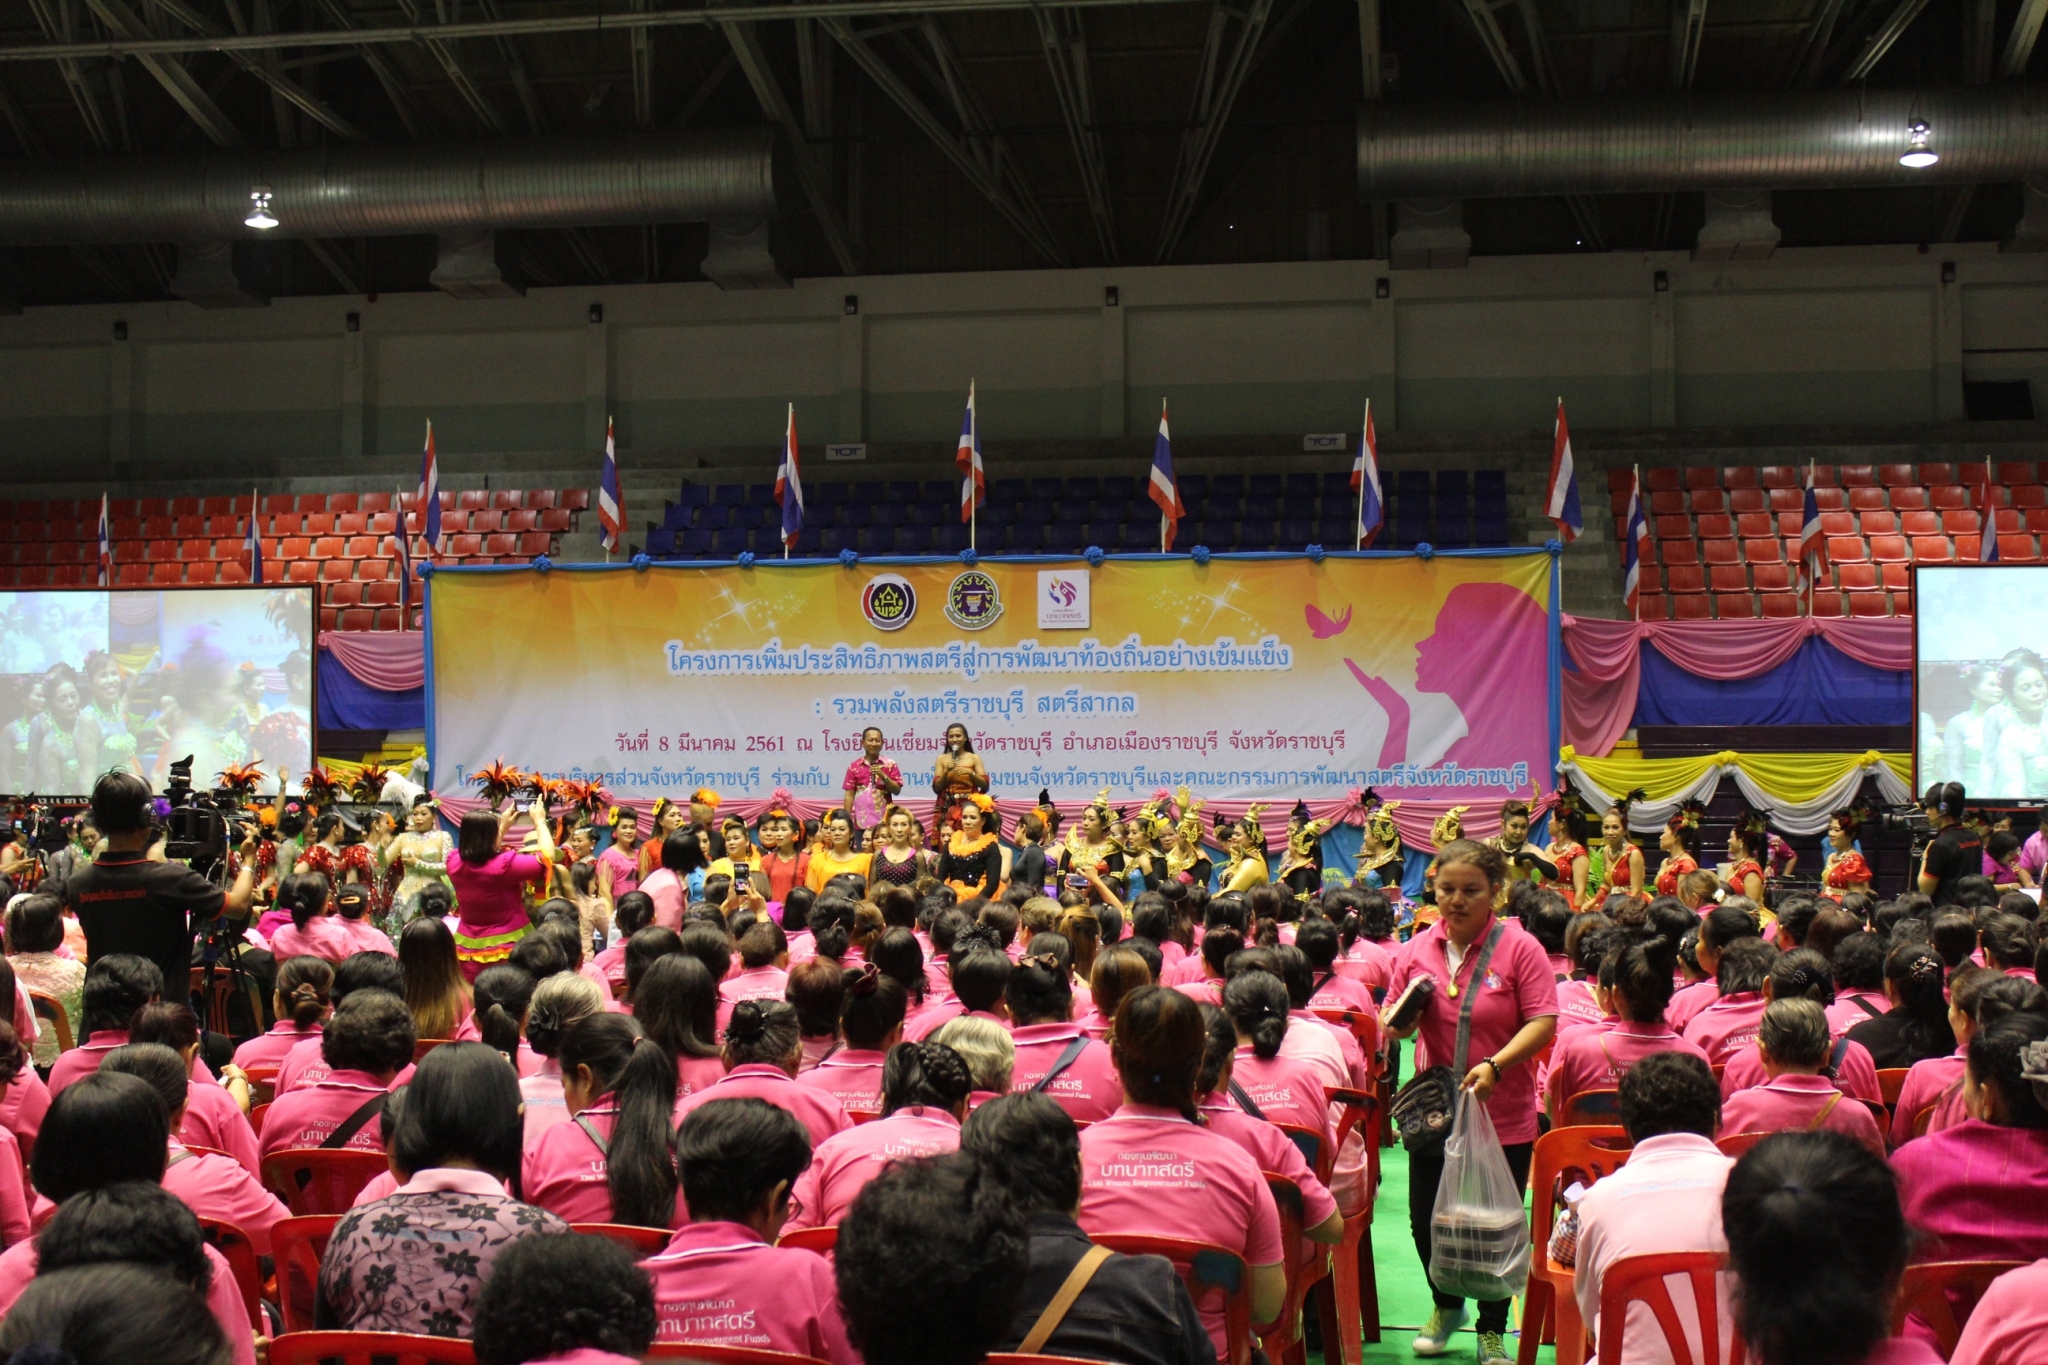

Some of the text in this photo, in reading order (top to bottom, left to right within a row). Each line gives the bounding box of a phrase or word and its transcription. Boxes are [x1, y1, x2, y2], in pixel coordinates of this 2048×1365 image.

[1308, 437, 1341, 446] TOT
[830, 447, 862, 456] TOT
[549, 537, 561, 557] G
[667, 639, 1289, 677] โครงการเพิ่มประสิทธิภาพสตรีสู่การพัฒนาท้องถิ่นอย่างเข้มแข็ง
[832, 688, 1024, 720] รวมพลังสตรีราชบุรี
[1036, 688, 1136, 713] สตรีสากล
[615, 729, 649, 751] วันที่
[658, 736, 669, 751] 8
[678, 732, 736, 751] มีนาคม
[746, 735, 785, 751] 2561
[797, 738, 813, 751] ณ
[1063, 730, 1218, 757] อำเภอเมืองราชบุรี
[1228, 729, 1346, 756] จังหวัดราชบุรี
[771, 767, 830, 786] ร่วมกับ
[1118, 1150, 1178, 1163] กองทุนพัฒนา
[1101, 1160, 1195, 1178] บทบาทสตรี
[1132, 1180, 1183, 1188] Empowerment
[663, 1299, 735, 1314] กองทุนพัฒนา
[655, 1309, 756, 1335] ทบาทสตรี
[744, 1333, 771, 1344] Funds
